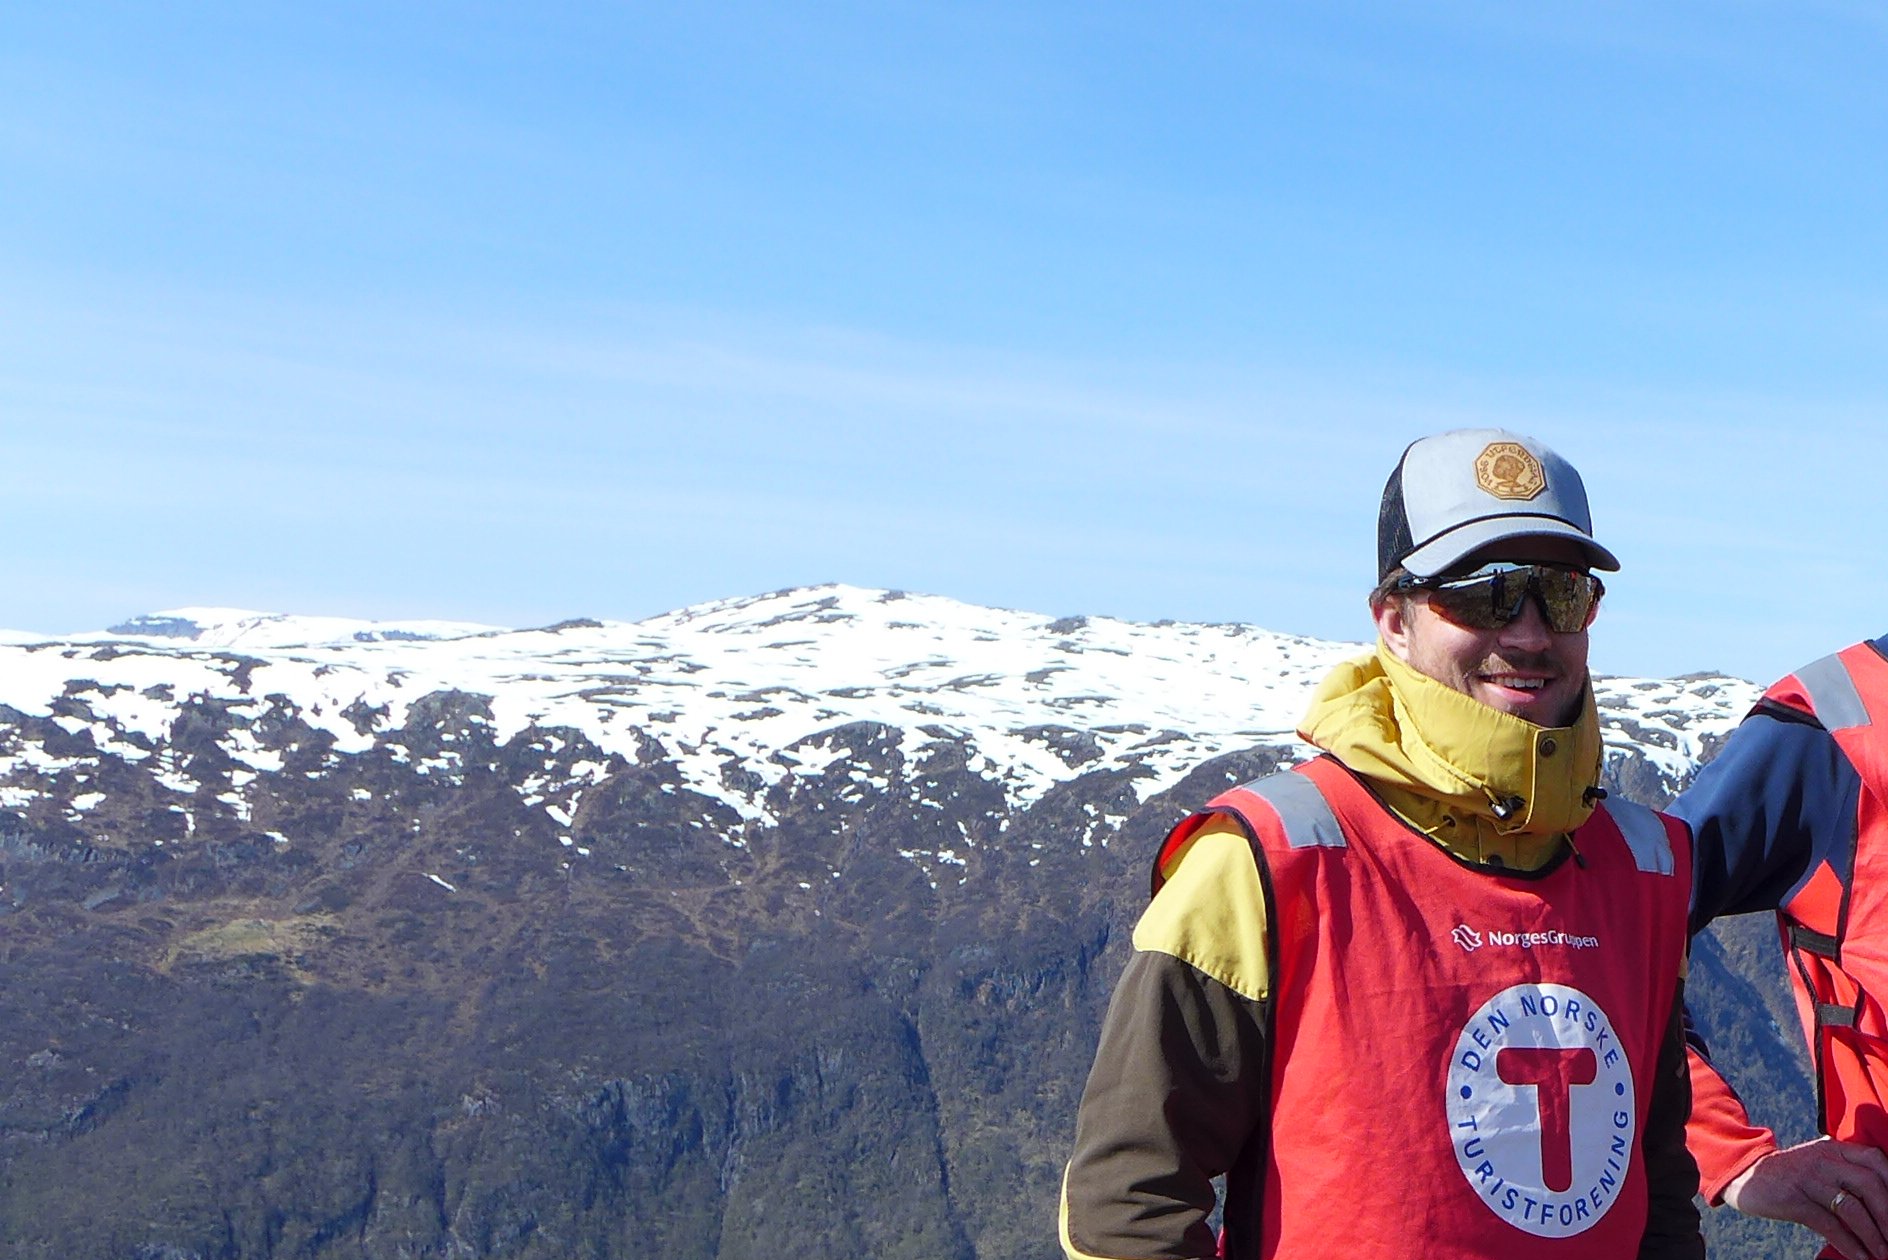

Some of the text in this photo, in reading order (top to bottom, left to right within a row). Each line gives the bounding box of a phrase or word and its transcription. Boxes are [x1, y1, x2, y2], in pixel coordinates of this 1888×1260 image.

[1488, 930, 1600, 950] NorgesGruppen
[1458, 995, 1629, 1226] DEN NORSKE TURISTFORENING
